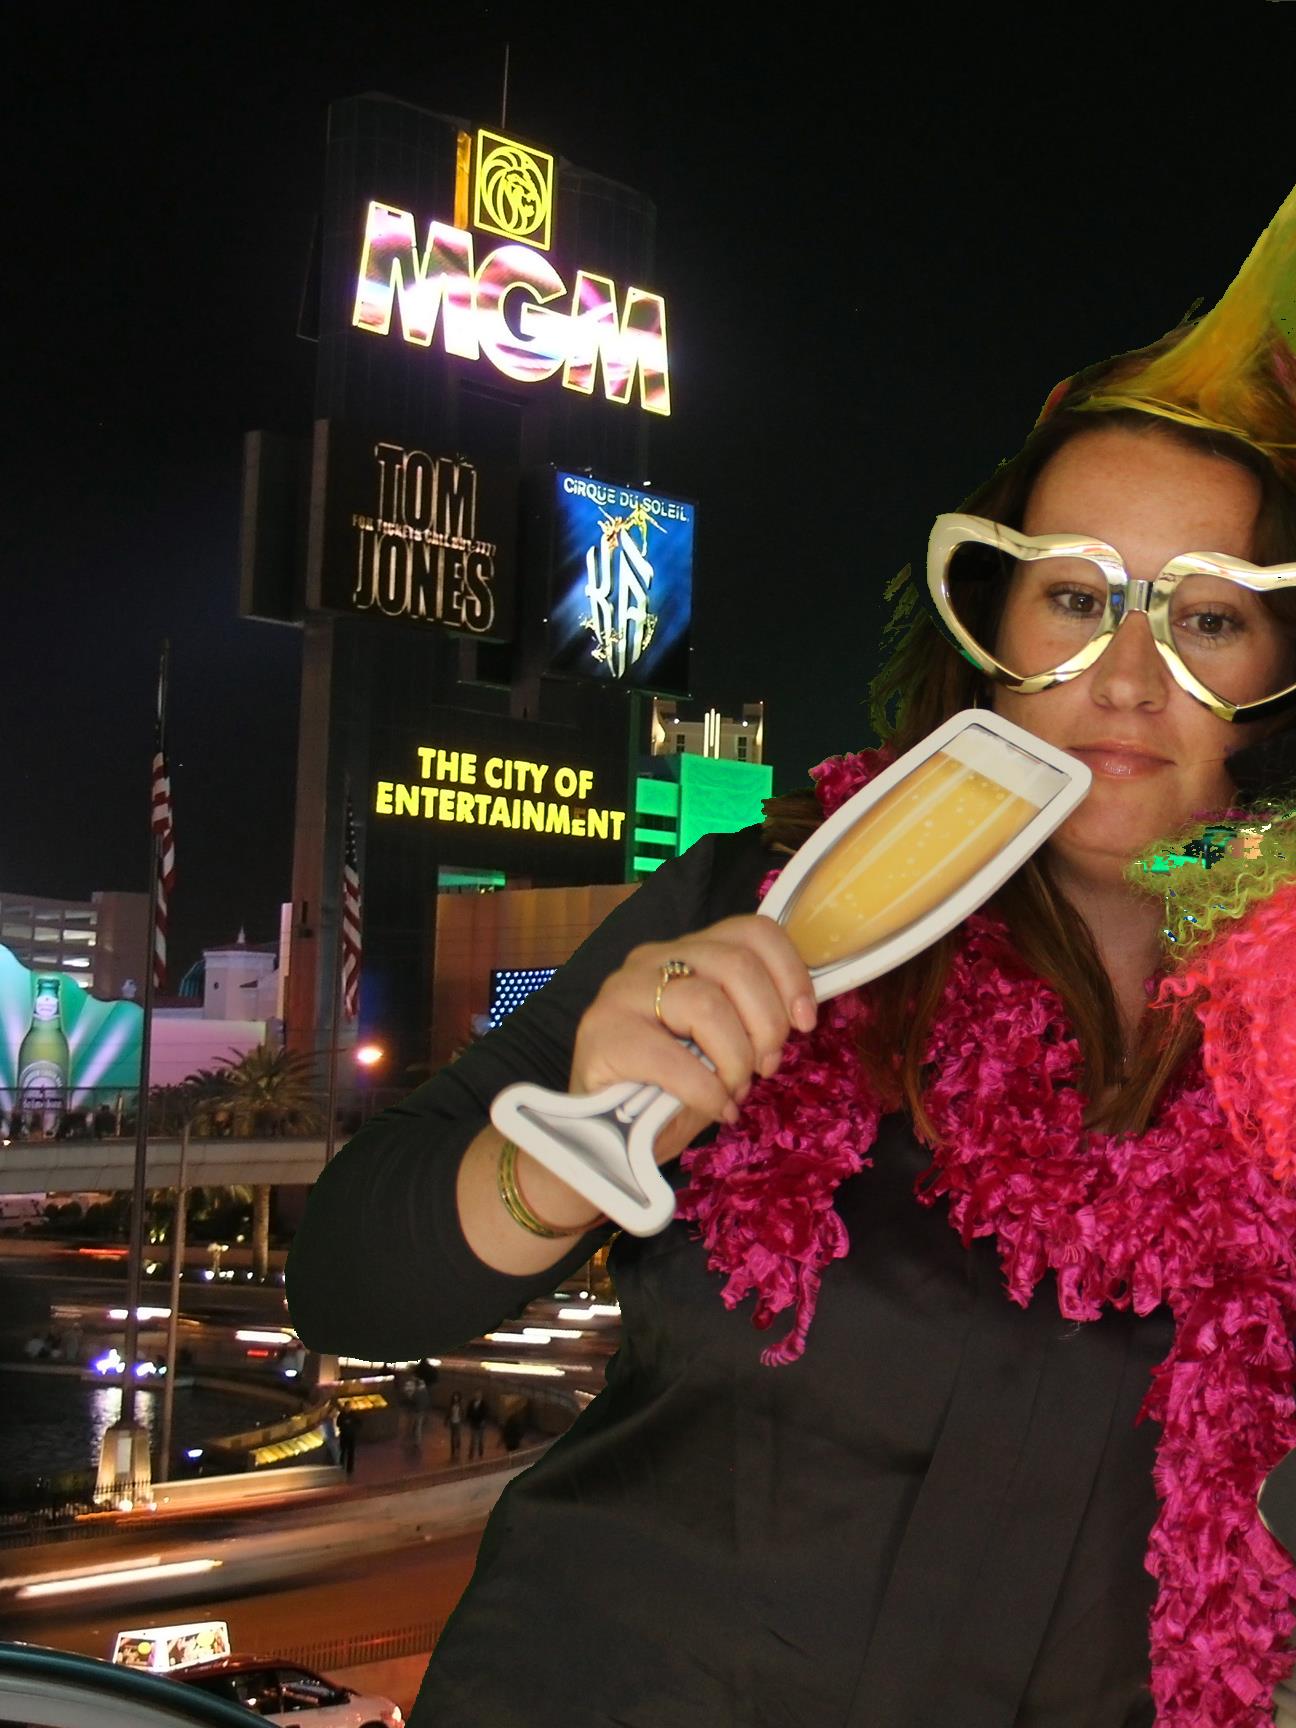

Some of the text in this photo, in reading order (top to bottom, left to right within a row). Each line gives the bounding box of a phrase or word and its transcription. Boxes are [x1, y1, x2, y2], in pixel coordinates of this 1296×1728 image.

[353, 200, 671, 416] MGM
[374, 442, 477, 541] TOM
[353, 530, 495, 632] JONES
[376, 781, 625, 840] ENTERTAINMENT
[417, 746, 594, 799] THE CITY OF
